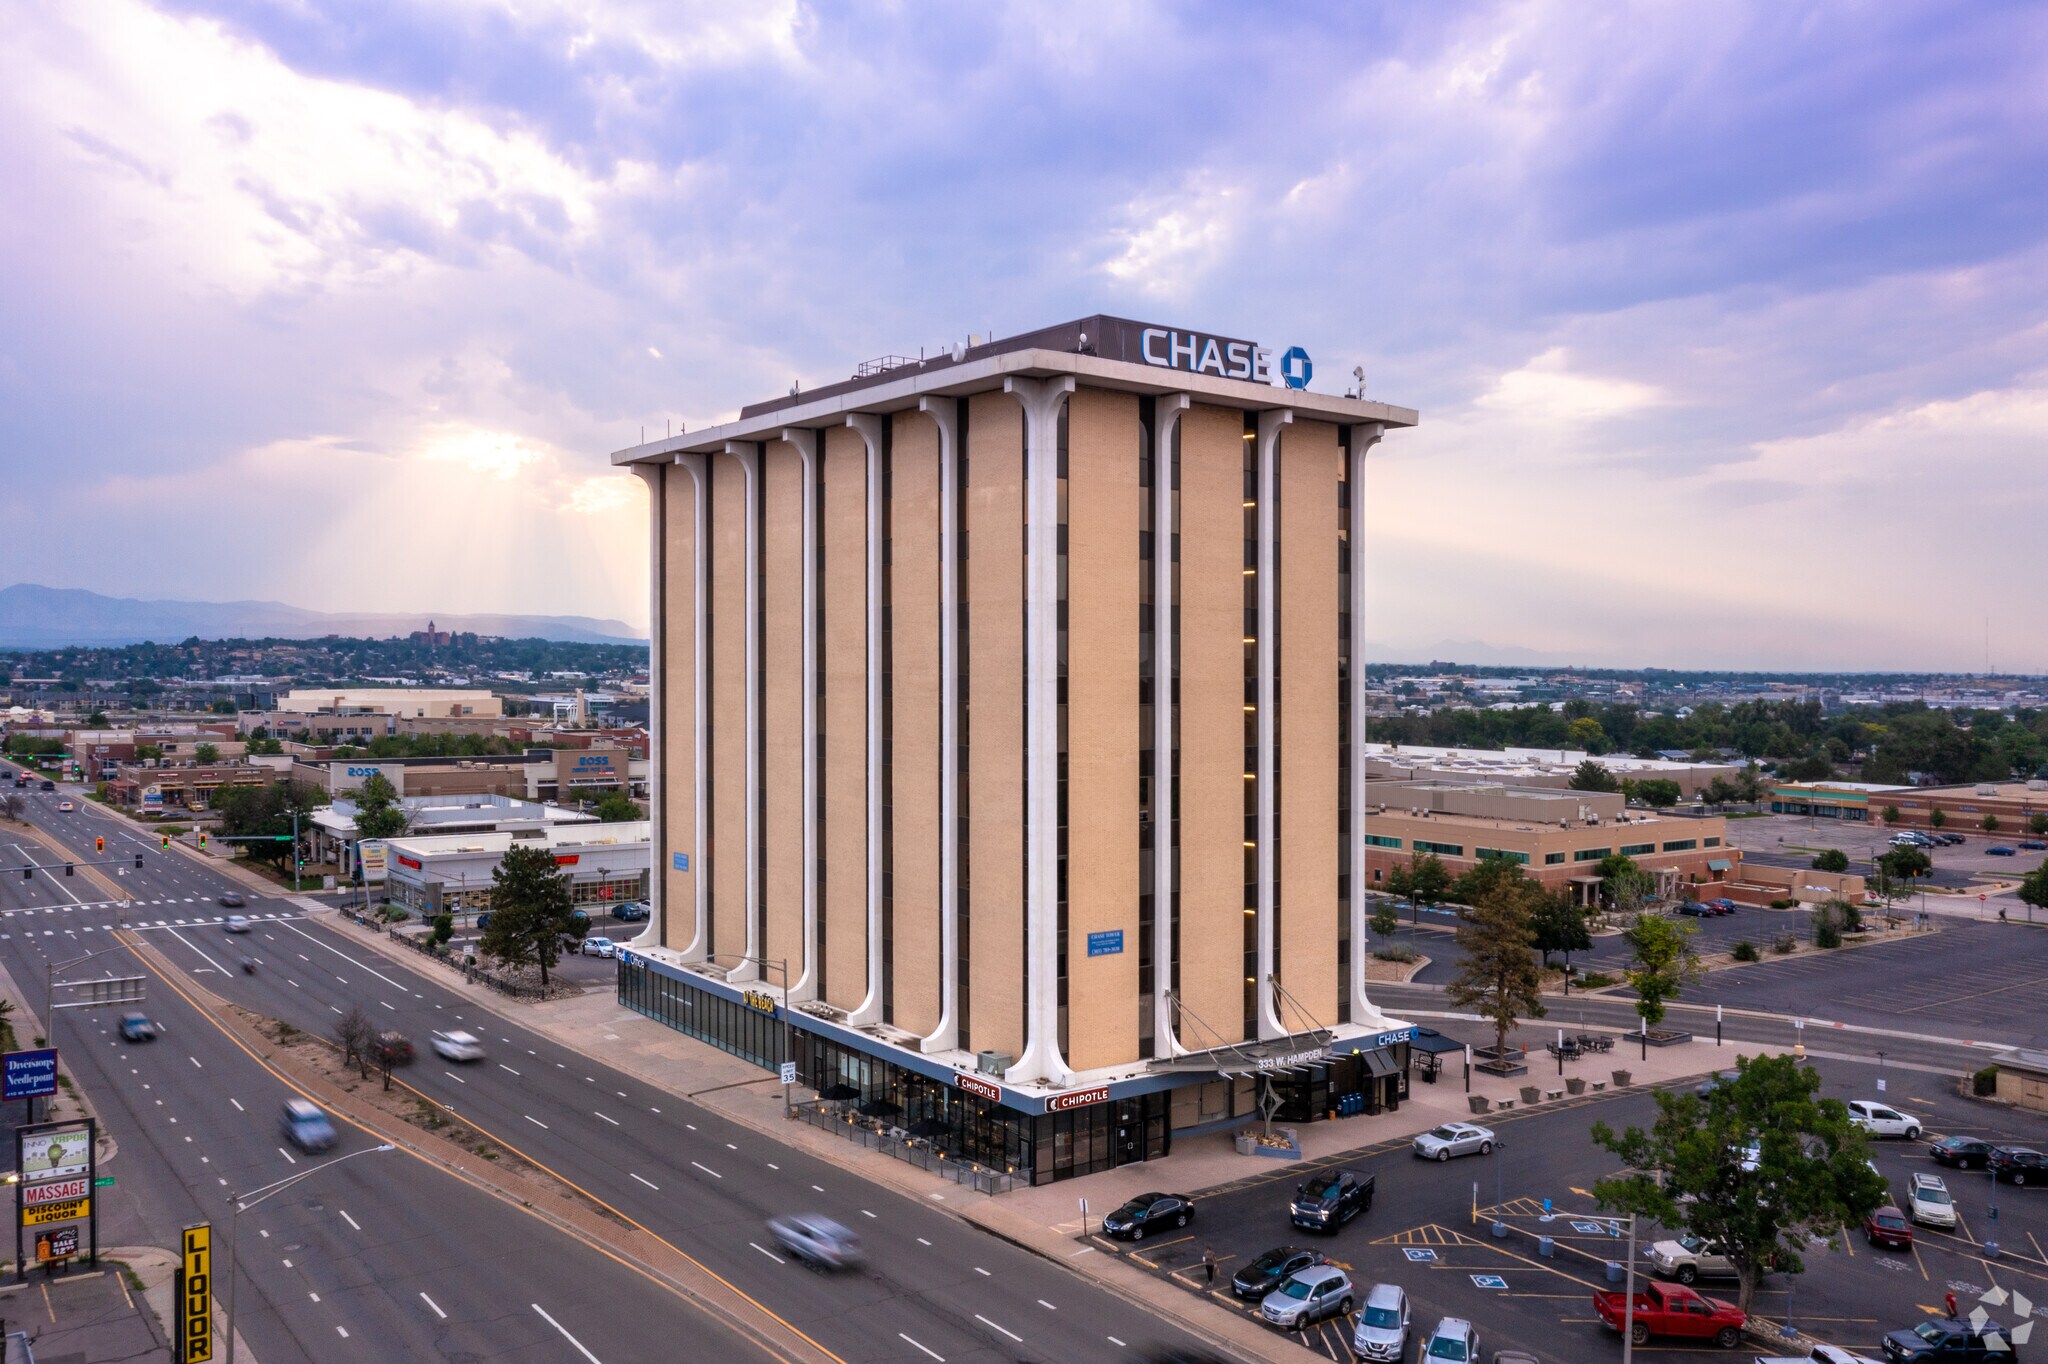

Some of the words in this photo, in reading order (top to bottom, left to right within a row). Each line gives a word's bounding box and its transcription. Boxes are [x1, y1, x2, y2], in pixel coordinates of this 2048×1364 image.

[1142, 328, 1273, 383] CHASE
[579, 755, 609, 765] ROSS
[348, 767, 379, 777] ROSS
[555, 854, 580, 865] FIRM
[1378, 1031, 1410, 1046] CHASE
[1258, 1058, 1274, 1069] 333
[1287, 1048, 1323, 1064] HAMPDEN
[783, 1073, 795, 1082] 35
[961, 1078, 997, 1099] CHIPOTLE
[1062, 1090, 1108, 1107] CHIPOTLE
[51, 1133, 87, 1144] VAPOR
[26, 1181, 86, 1203] MASSAGE
[28, 1200, 84, 1215] DISCOUNT
[35, 1210, 77, 1223] LIQUOR
[53, 1239, 74, 1248] SALE
[188, 1234, 208, 1359] LIQUOR
